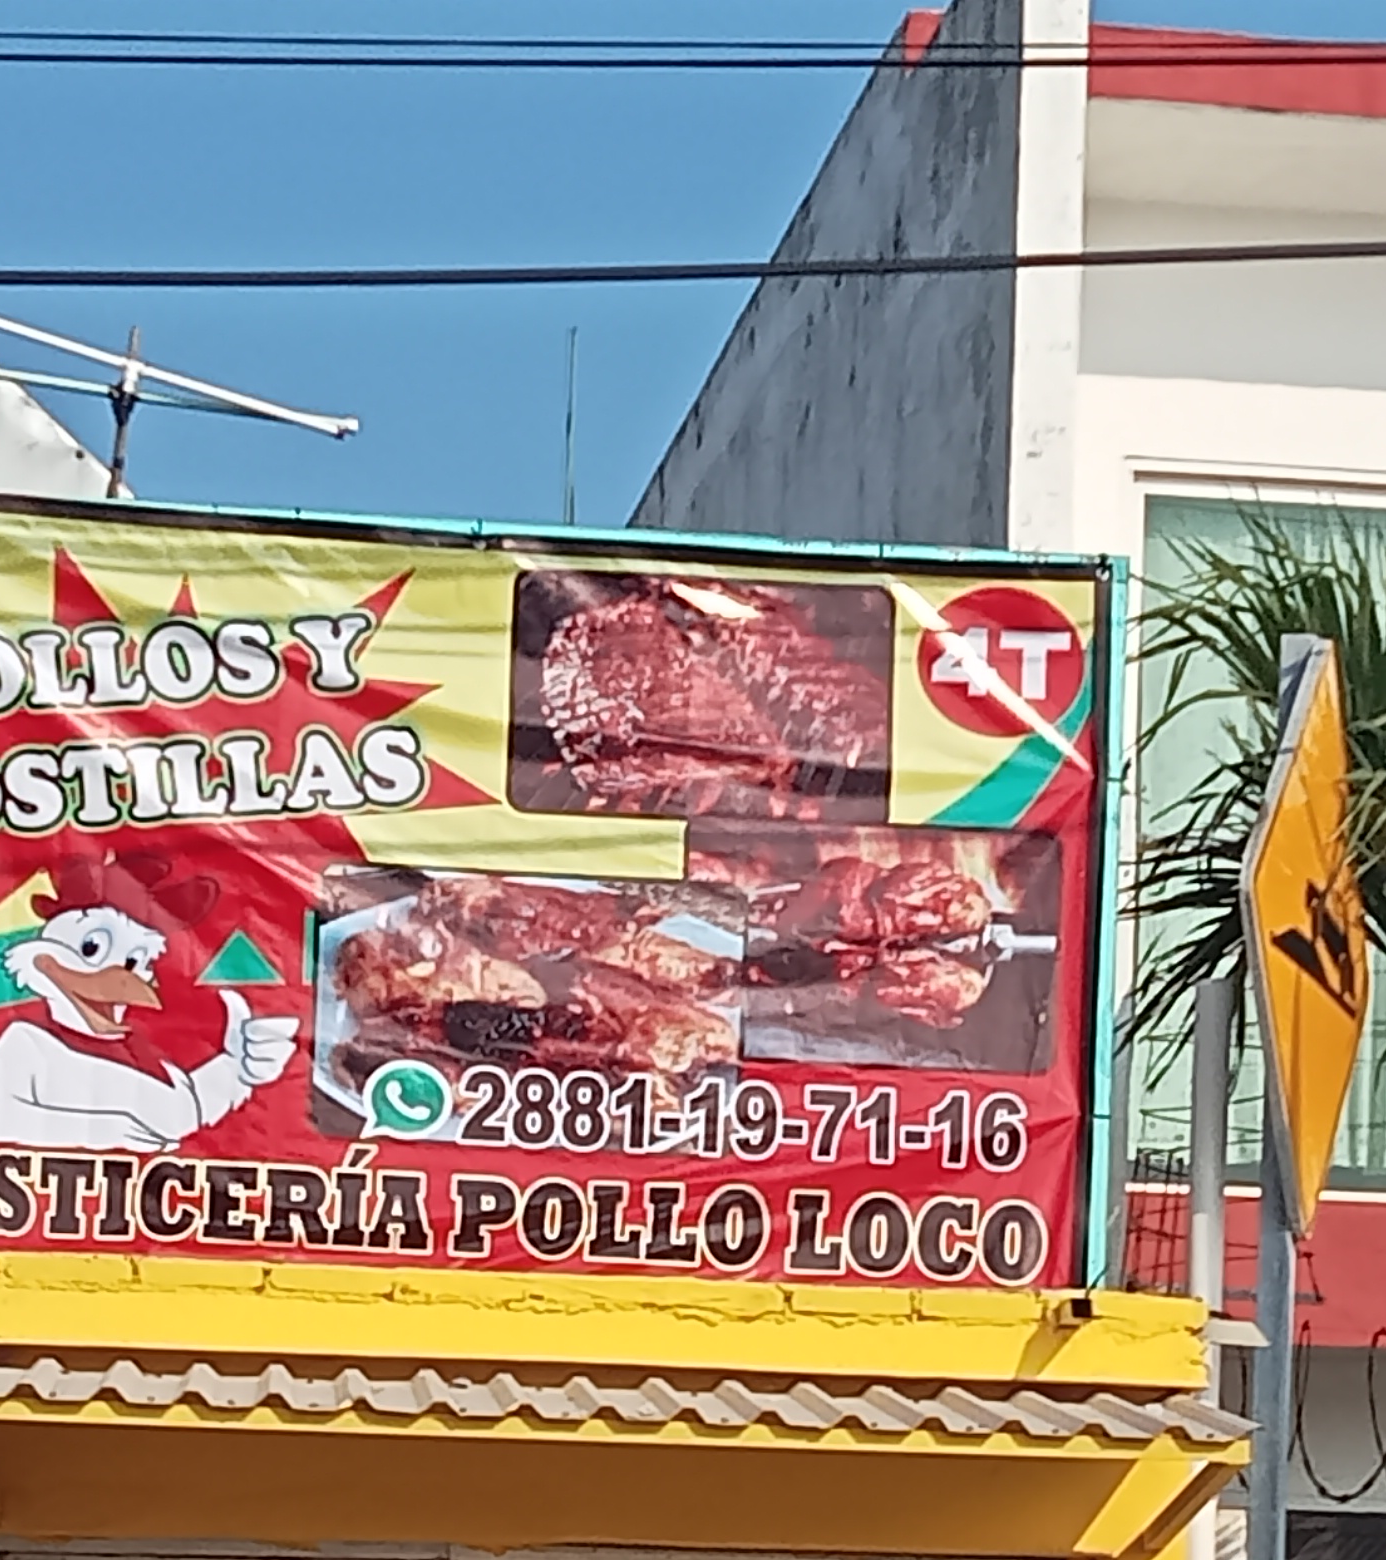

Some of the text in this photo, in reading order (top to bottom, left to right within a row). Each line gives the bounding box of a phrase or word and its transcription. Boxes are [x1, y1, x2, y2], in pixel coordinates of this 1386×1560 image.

[289, 608, 375, 695] Y
[930, 627, 1072, 698] 4T
[459, 1068, 1026, 1171] 2881-19-71-16
[450, 1174, 772, 1270] POLLO
[783, 1188, 1049, 1288] LOCO
